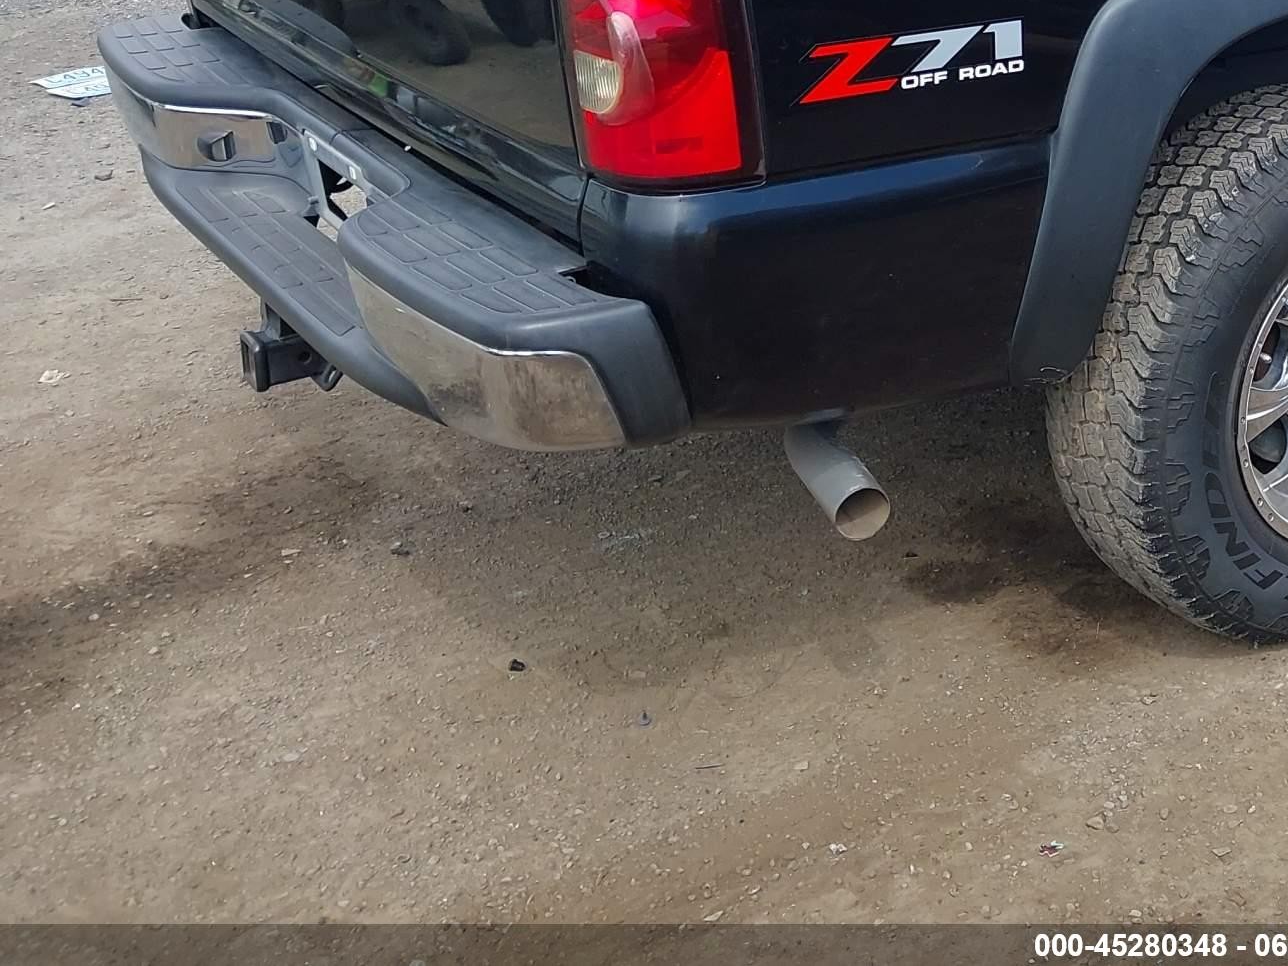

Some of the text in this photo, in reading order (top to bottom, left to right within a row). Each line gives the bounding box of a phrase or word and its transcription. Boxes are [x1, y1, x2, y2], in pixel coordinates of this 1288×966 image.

[798, 18, 1023, 104] Z71
[901, 59, 1025, 90] OFF ROAD
